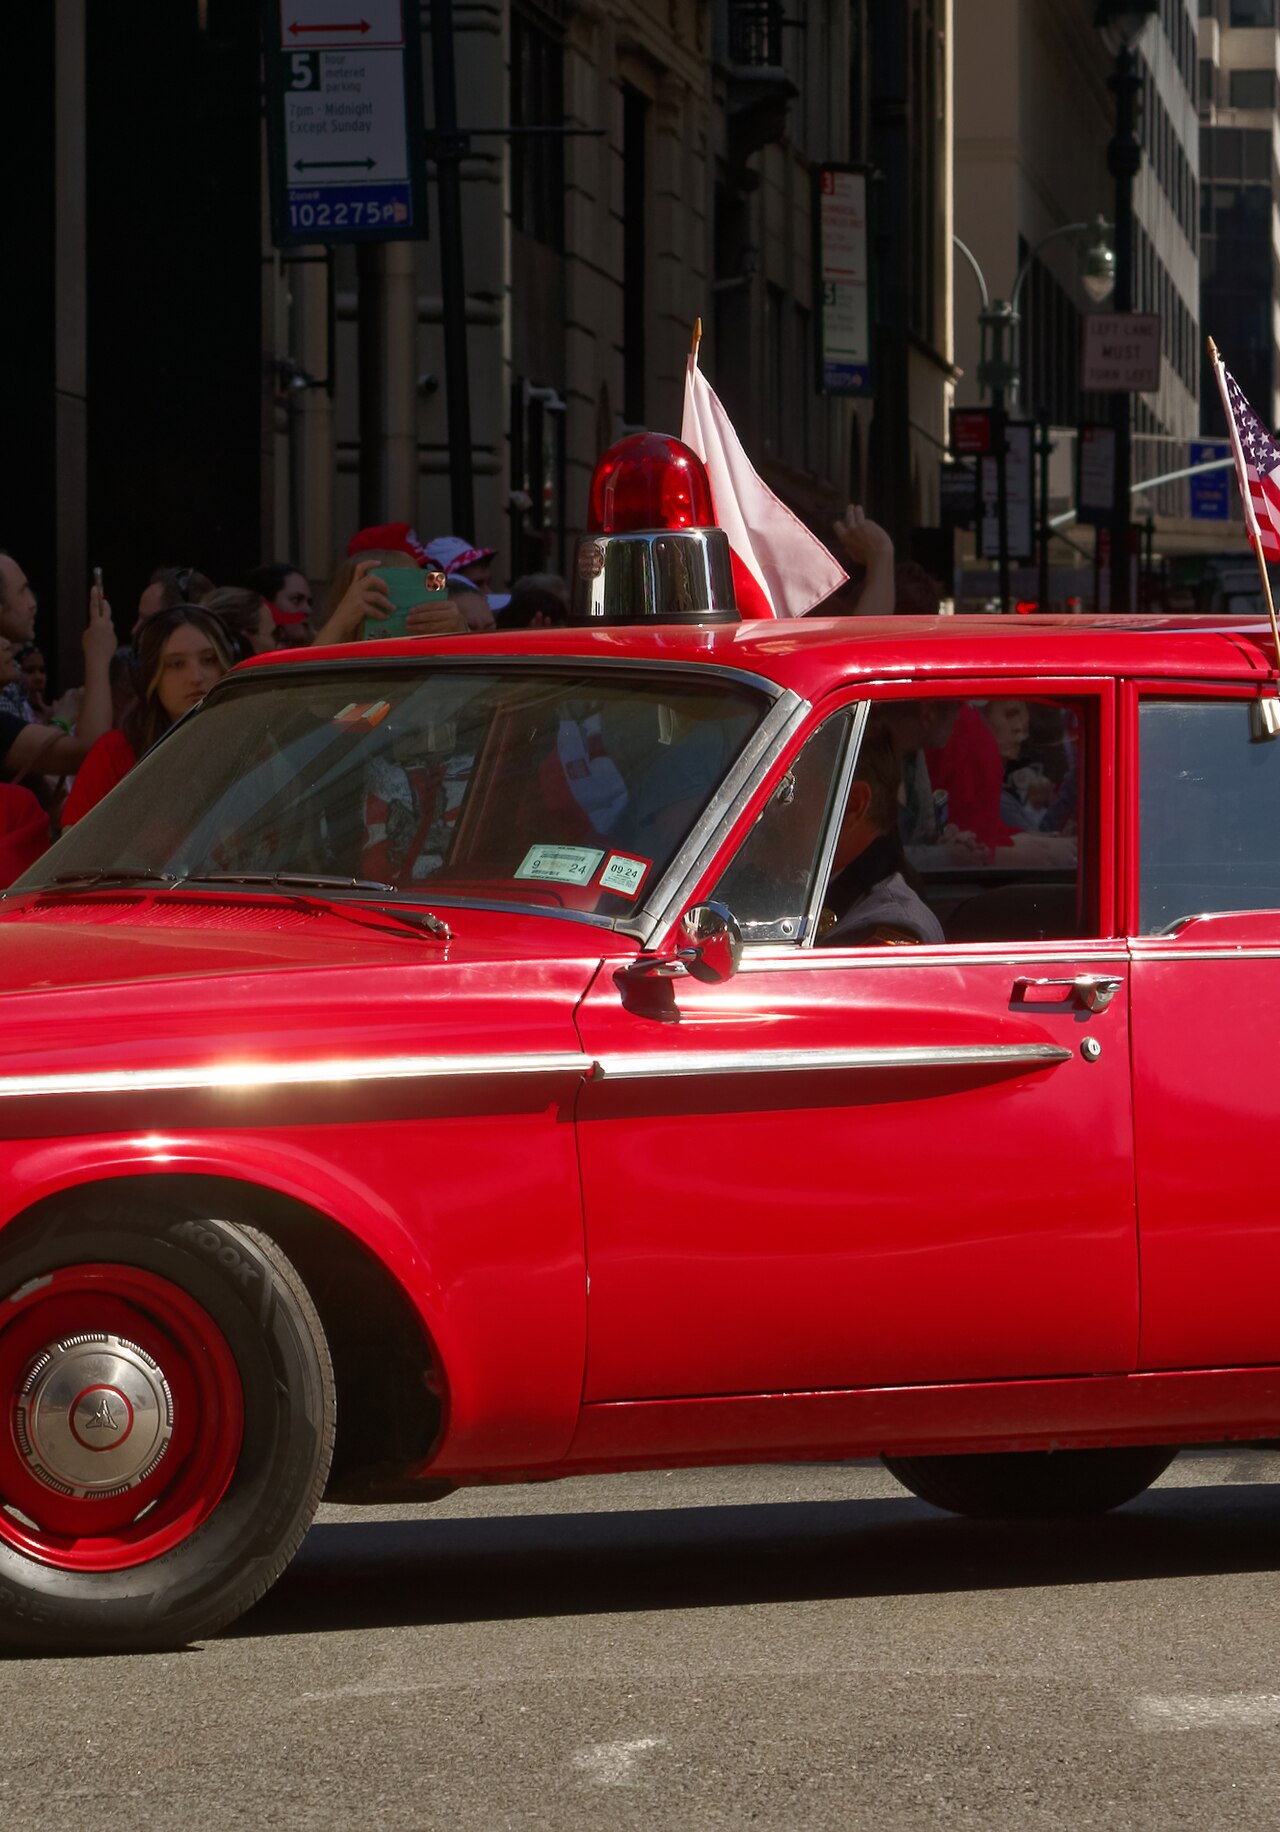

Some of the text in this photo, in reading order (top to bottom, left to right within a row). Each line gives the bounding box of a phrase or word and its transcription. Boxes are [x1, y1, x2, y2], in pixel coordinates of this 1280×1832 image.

[325, 55, 346, 65] hour
[291, 53, 313, 89] 5
[325, 67, 365, 78] metered
[326, 82, 361, 94] parking
[289, 104, 314, 118] 7pm
[325, 102, 373, 116] Midnight
[289, 119, 372, 135] Except Sunday
[289, 202, 381, 227] 102275
[1102, 345, 1141, 360] MUST
[532, 860, 541, 870] 9
[569, 864, 587, 875] 24
[611, 864, 638, 878] 09 24
